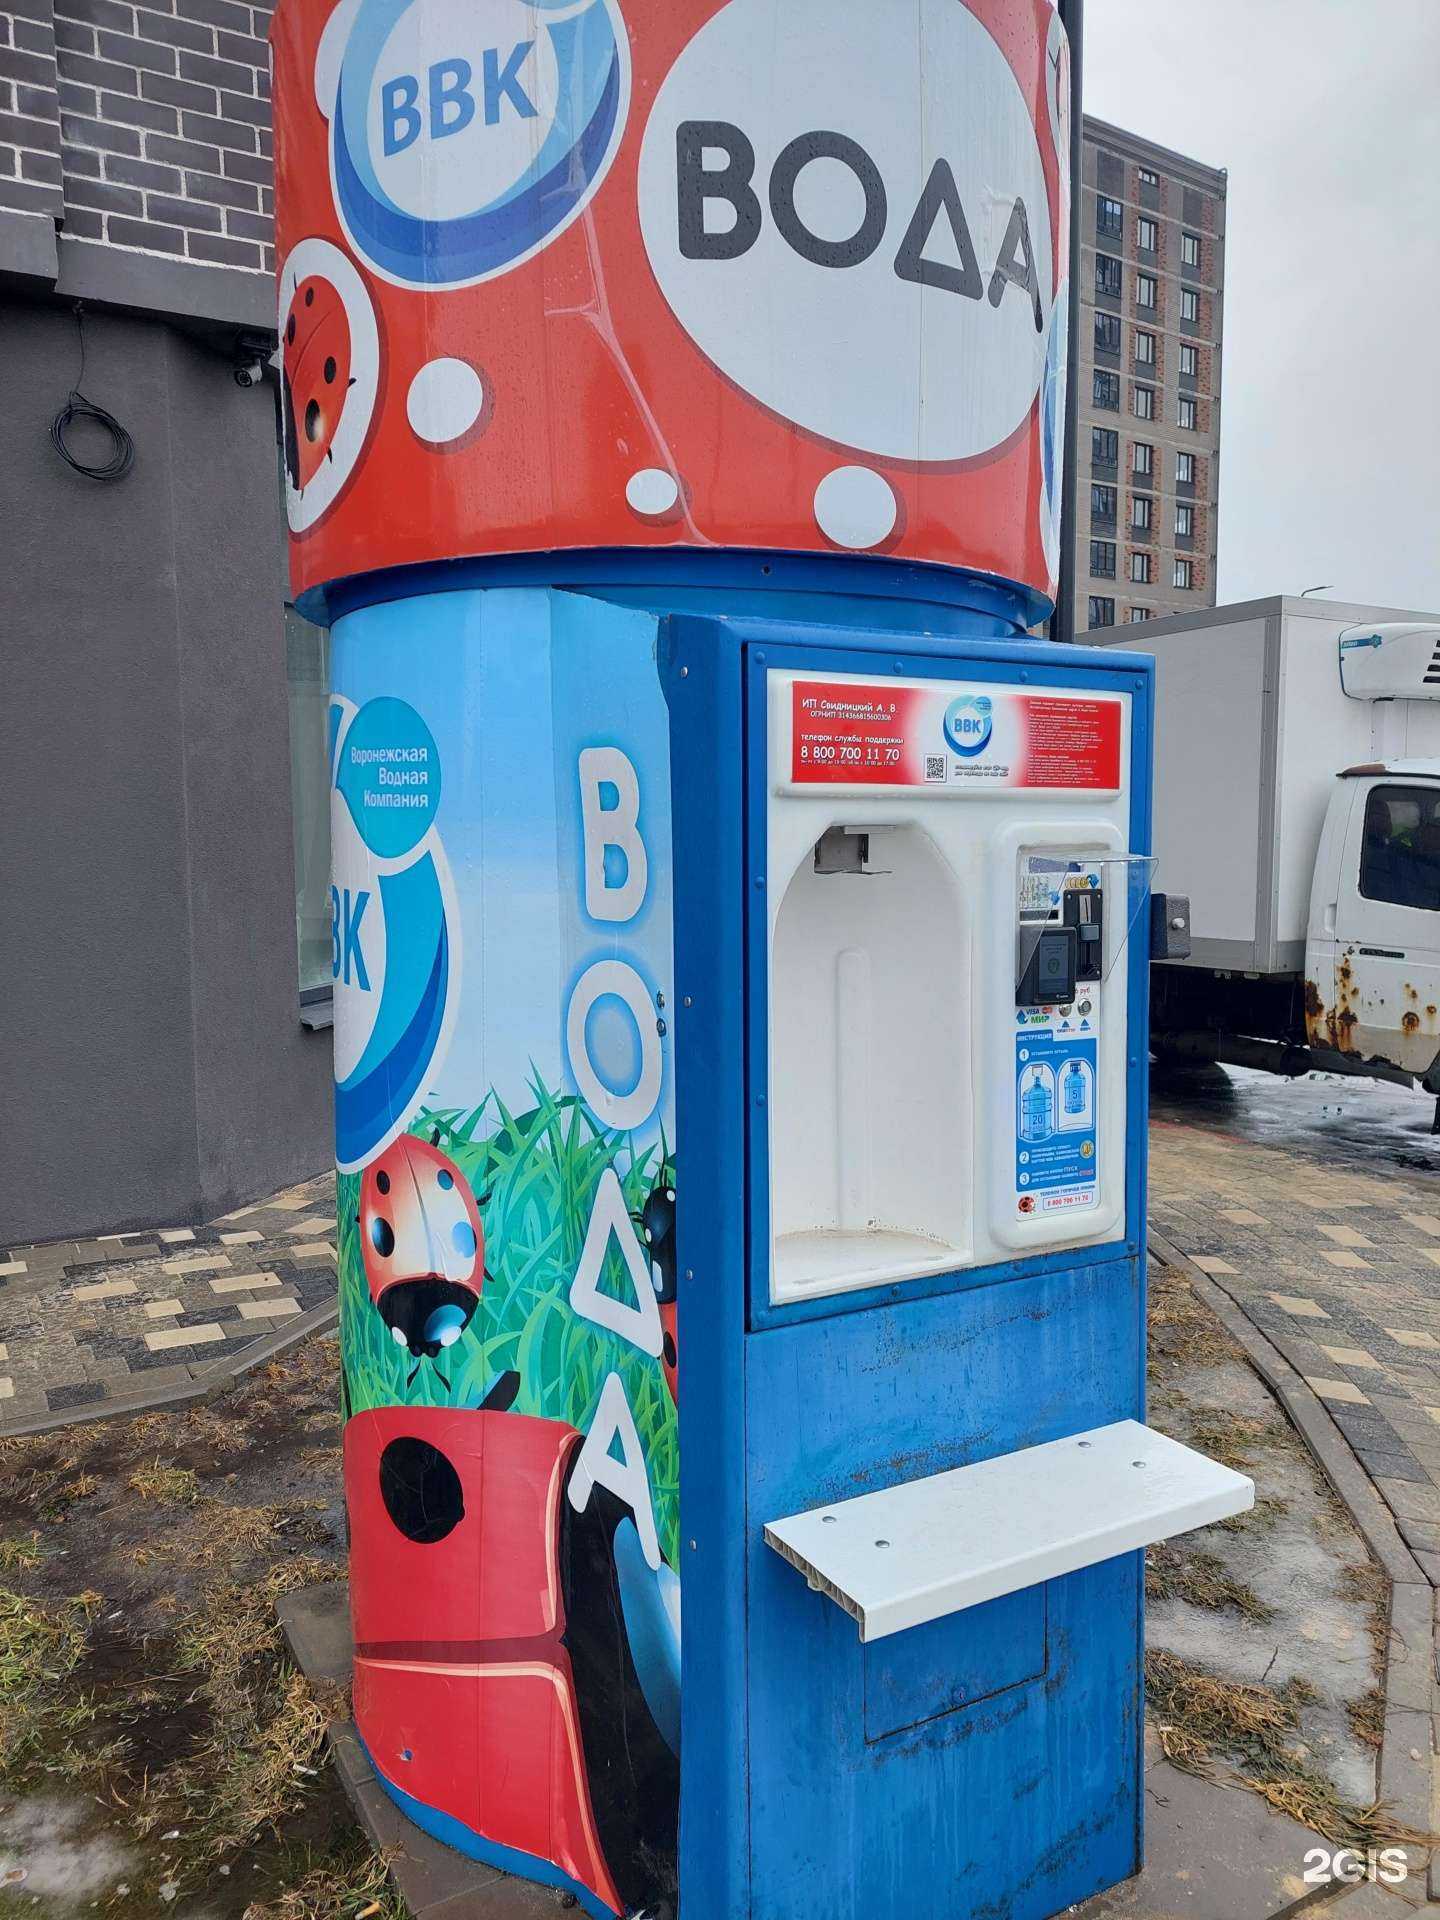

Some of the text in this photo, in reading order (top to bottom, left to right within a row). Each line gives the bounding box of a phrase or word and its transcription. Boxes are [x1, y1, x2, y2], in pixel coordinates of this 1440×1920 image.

[382, 40, 538, 157] ВВК
[676, 120, 1044, 333] ВОДА
[802, 698, 817, 709] ИП
[820, 699, 873, 713] Свидницкий
[810, 710, 836, 719] ОГРНИП
[954, 718, 981, 733] ВВК
[800, 734, 904, 746] телефон службы поддержки
[351, 746, 428, 767] Воронежская
[800, 745, 900, 761] 8 800 700 11 70
[378, 767, 428, 786] Водная
[363, 789, 429, 808] Компания
[1072, 1090, 1078, 1099] 5
[1032, 1114, 1043, 1125] 20
